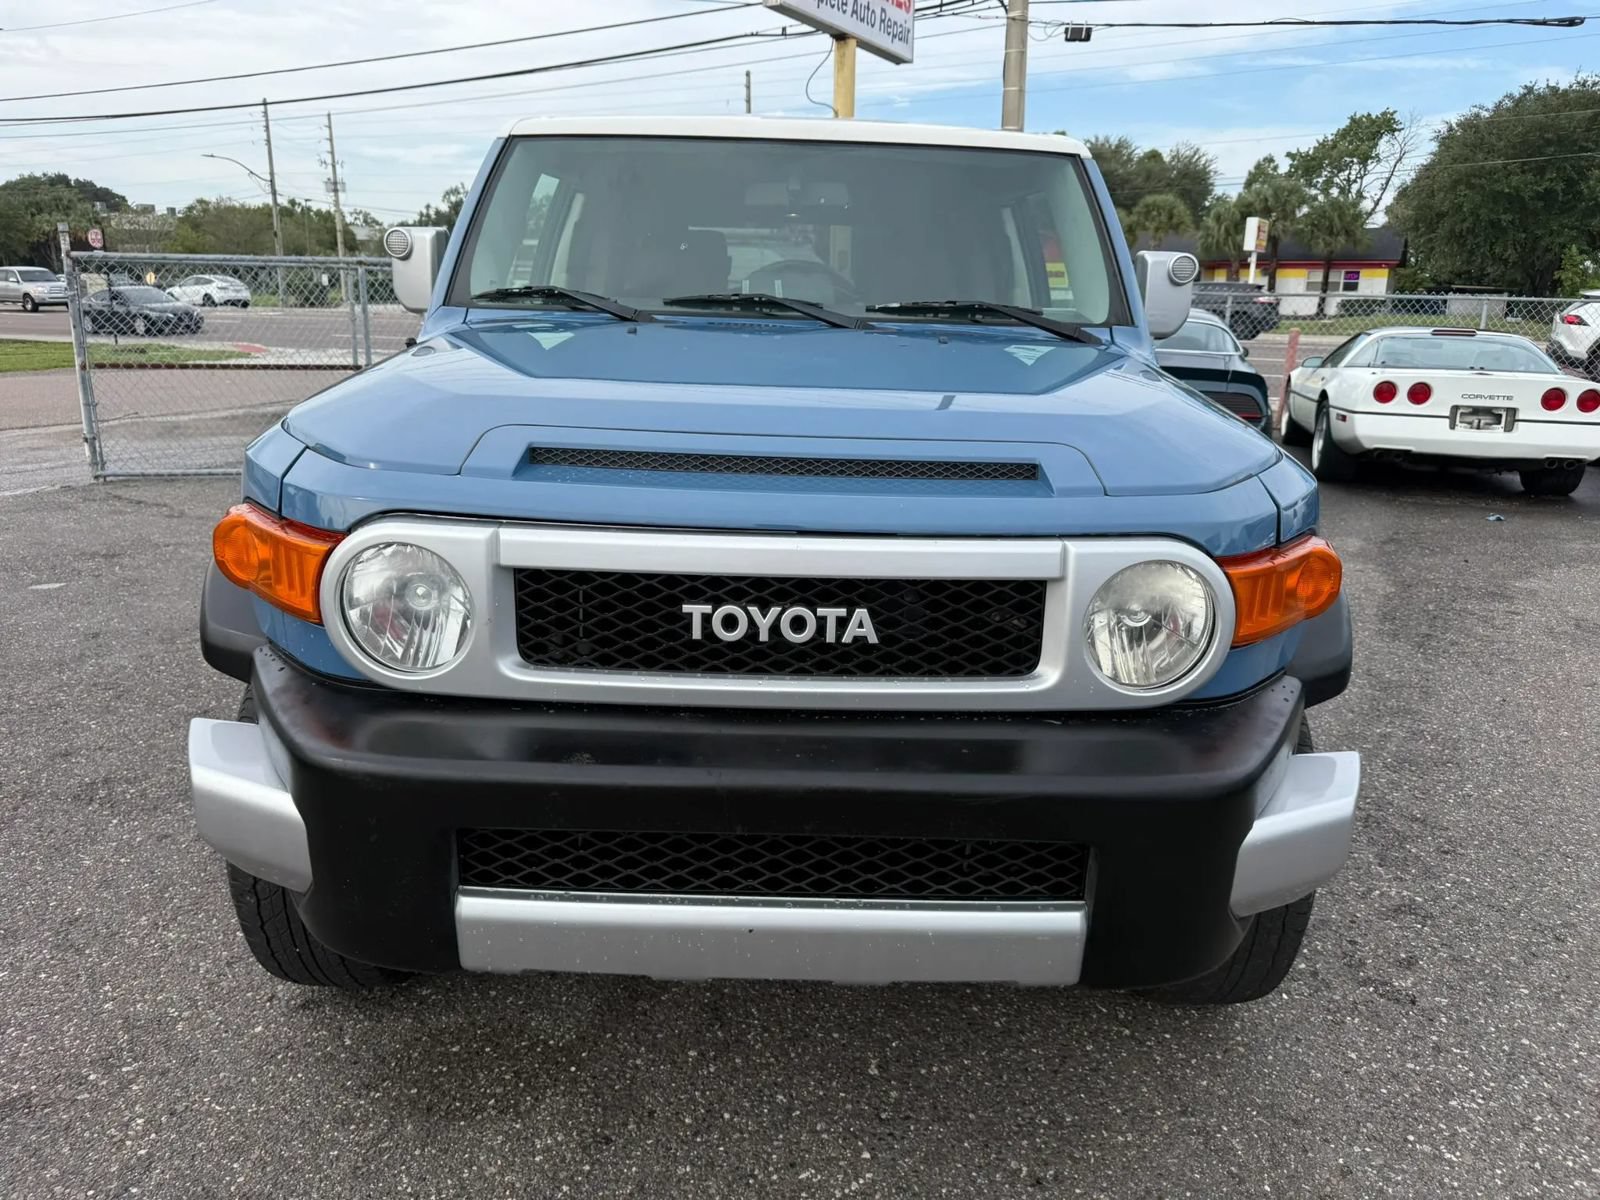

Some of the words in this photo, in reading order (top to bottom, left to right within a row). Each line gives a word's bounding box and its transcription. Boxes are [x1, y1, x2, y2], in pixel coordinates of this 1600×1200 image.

[851, 0, 876, 28] Auto
[879, 6, 911, 45] Repair
[1461, 393, 1514, 401] CORVETTE
[682, 604, 879, 644] TOYOTA
